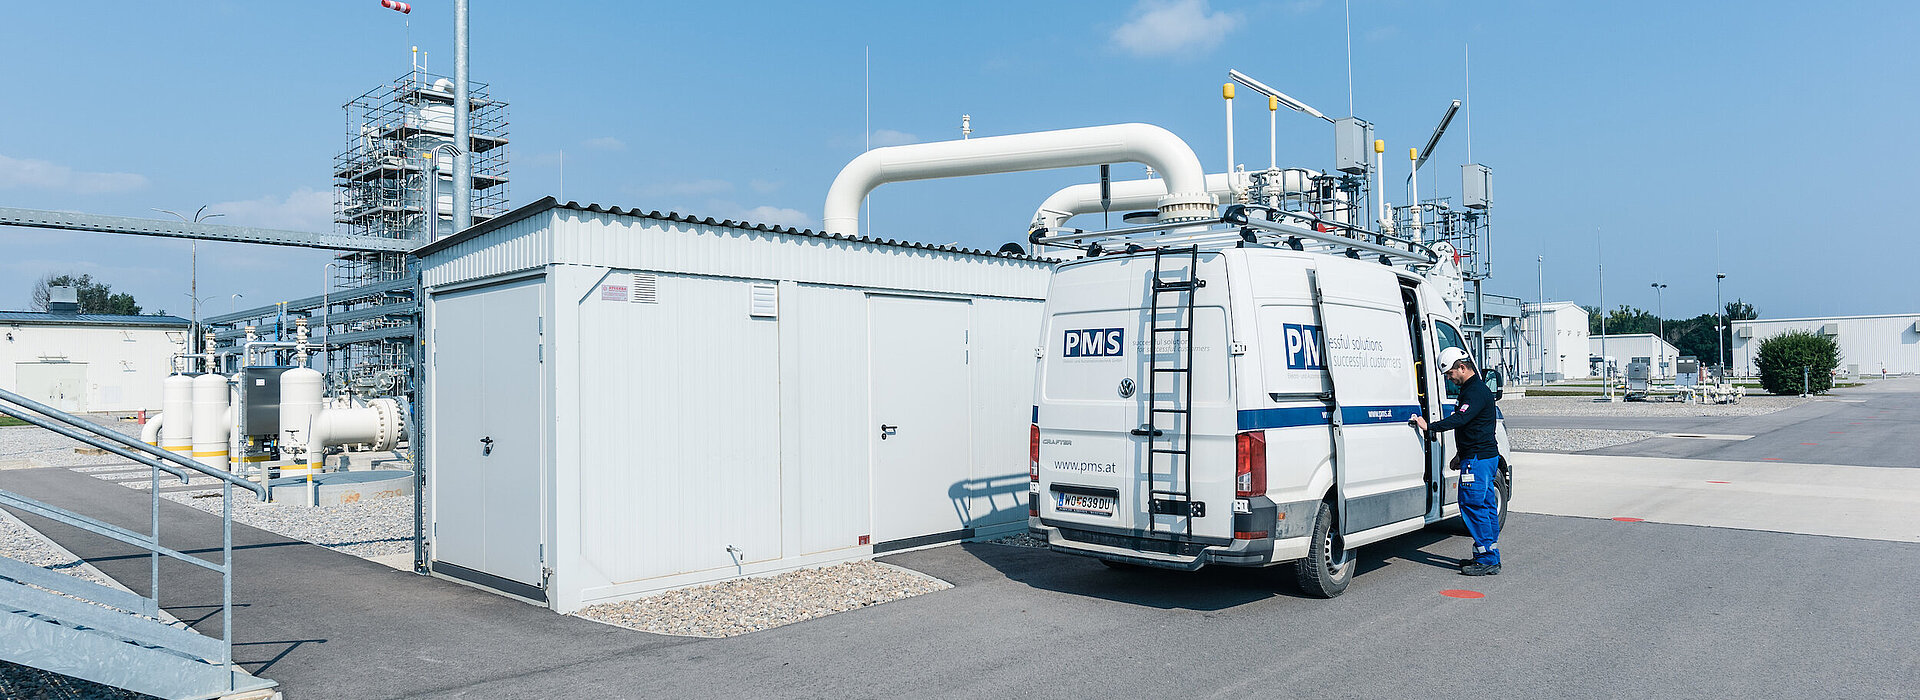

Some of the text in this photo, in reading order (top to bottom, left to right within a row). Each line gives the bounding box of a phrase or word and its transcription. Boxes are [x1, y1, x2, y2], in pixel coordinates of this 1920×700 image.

[1065, 330, 1121, 356] PMS
[1286, 328, 1327, 366] PM
[1352, 337, 1383, 352] solutions
[1333, 352, 1402, 369] successful customers
[1054, 461, 1116, 474] www.pms.at
